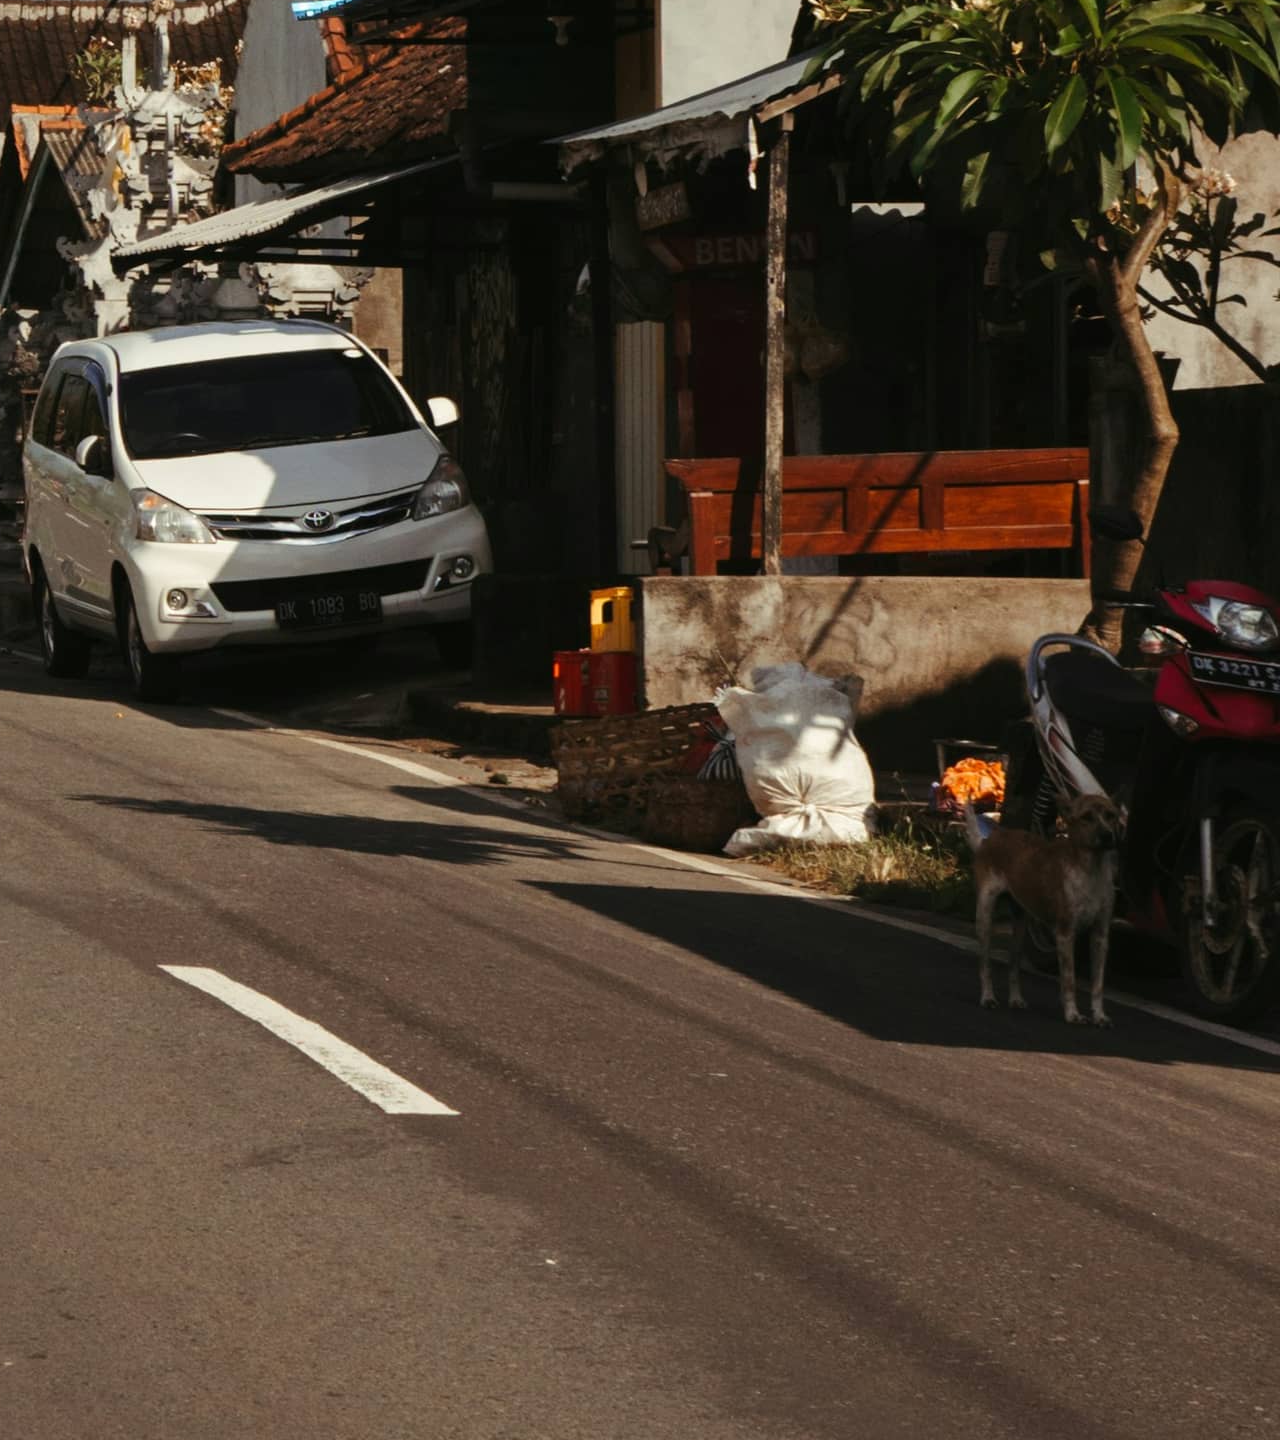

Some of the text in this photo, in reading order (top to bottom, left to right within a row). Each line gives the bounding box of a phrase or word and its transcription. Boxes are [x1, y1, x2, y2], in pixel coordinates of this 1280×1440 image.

[695, 232, 816, 265] BENN
[279, 600, 297, 620] DK
[309, 595, 345, 616] 1083
[1193, 657, 1215, 671] DK
[1218, 661, 1260, 677] 3221
